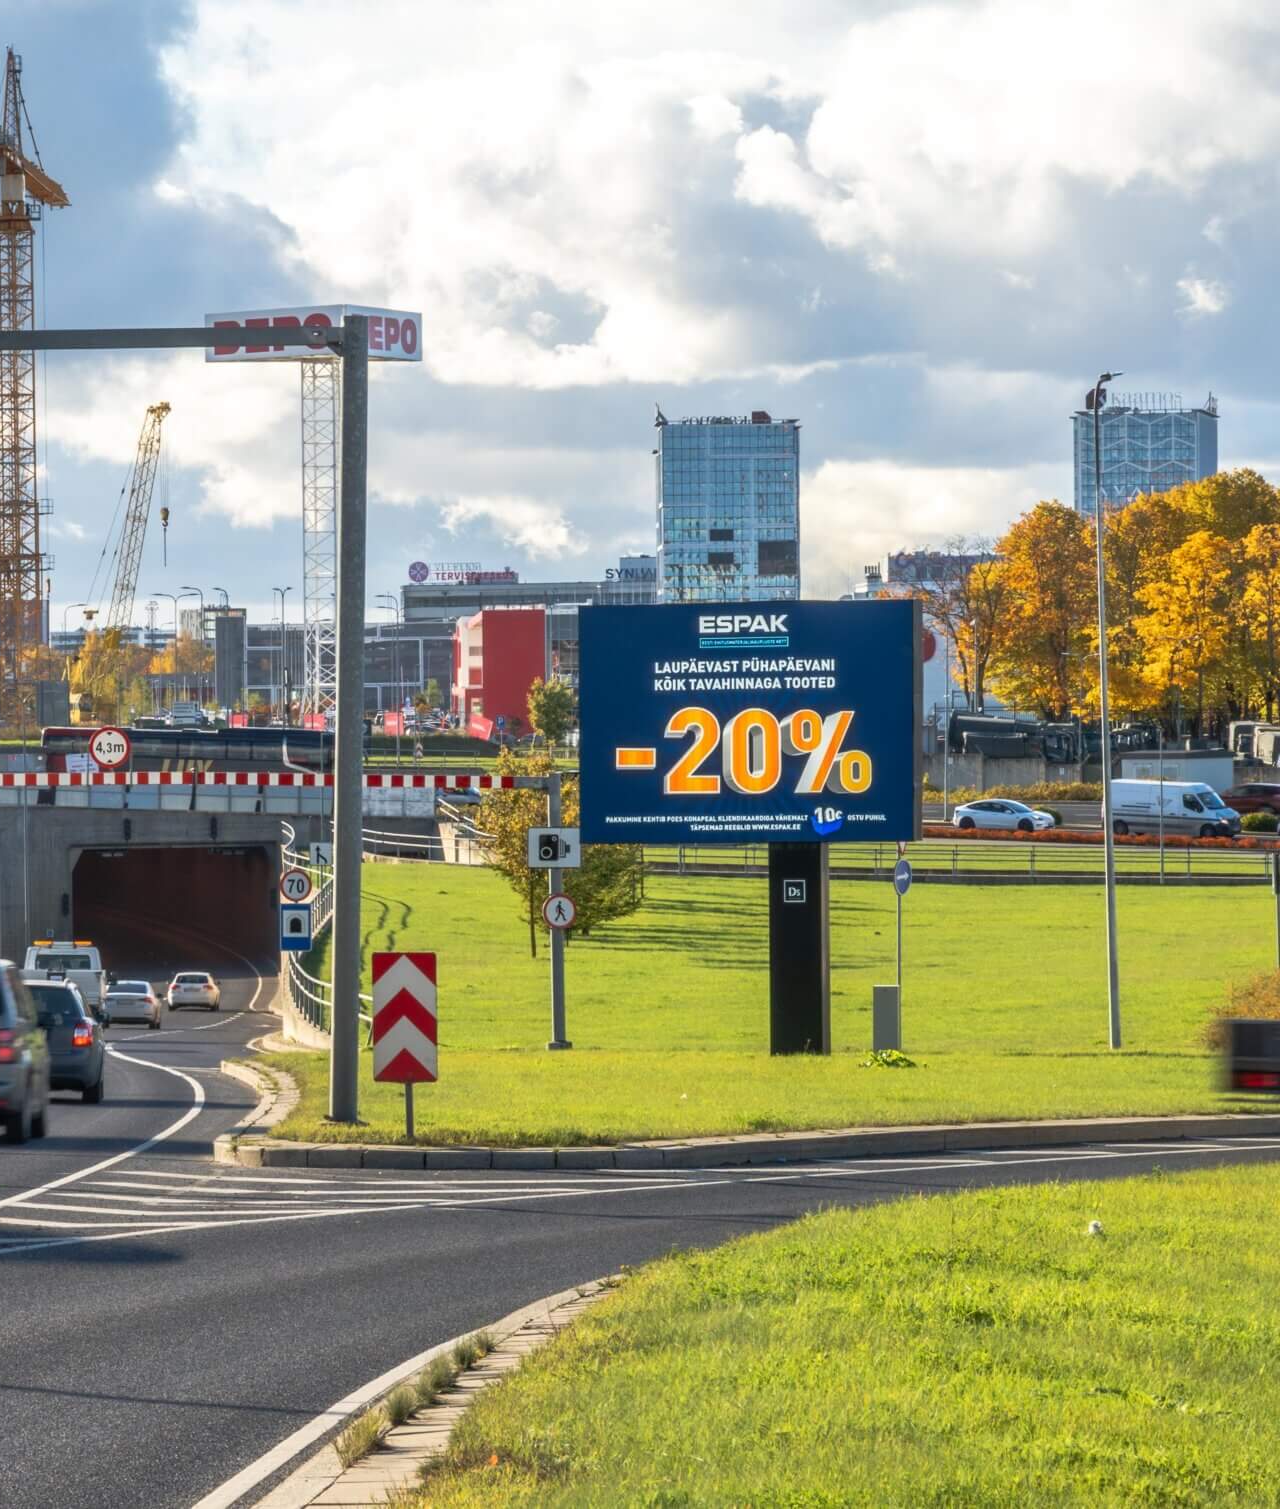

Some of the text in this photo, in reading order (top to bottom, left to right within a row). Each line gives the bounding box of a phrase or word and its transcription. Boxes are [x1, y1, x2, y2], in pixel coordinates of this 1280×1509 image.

[358, 314, 417, 354] EPO
[698, 614, 789, 634] ESPAK
[654, 656, 836, 674] LAUPÄEVAST PÜHAPÄEVANI
[654, 676, 836, 691] KÕIK TAVAHINNAGA TOOTED
[615, 706, 873, 795] -20%
[605, 815, 642, 824] PAKKUMINE
[643, 815, 666, 823] KEHTIB
[684, 815, 716, 823] KOHAPEAL
[775, 812, 809, 822] VÄHEMALT
[847, 814, 864, 822] OSTU
[690, 822, 723, 831] TÄPSEMAD
[724, 823, 751, 831] REEGLID
[287, 879, 305, 894] 70
[788, 887, 801, 897] Ds
